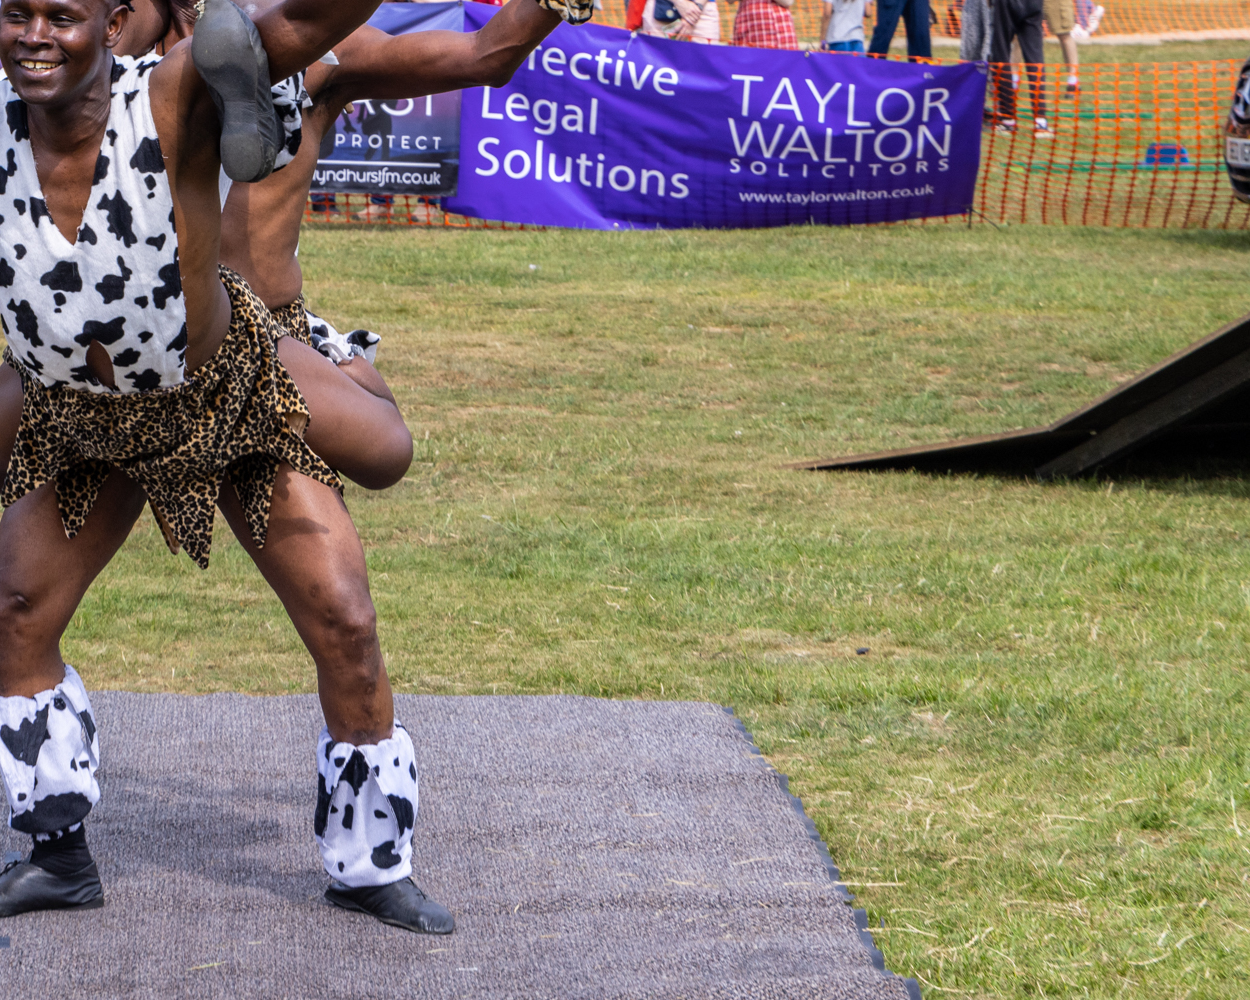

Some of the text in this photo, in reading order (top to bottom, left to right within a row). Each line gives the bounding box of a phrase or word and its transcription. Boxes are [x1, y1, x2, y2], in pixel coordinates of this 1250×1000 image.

[481, 86, 598, 136] Legal
[731, 73, 952, 127] TAYLOR
[335, 133, 442, 151] PROTECT
[727, 117, 952, 163] WALTON
[474, 136, 690, 200] Solutions
[729, 158, 949, 179] SOLICITORS
[738, 184, 935, 206] www.taylorwalton.co.uk
